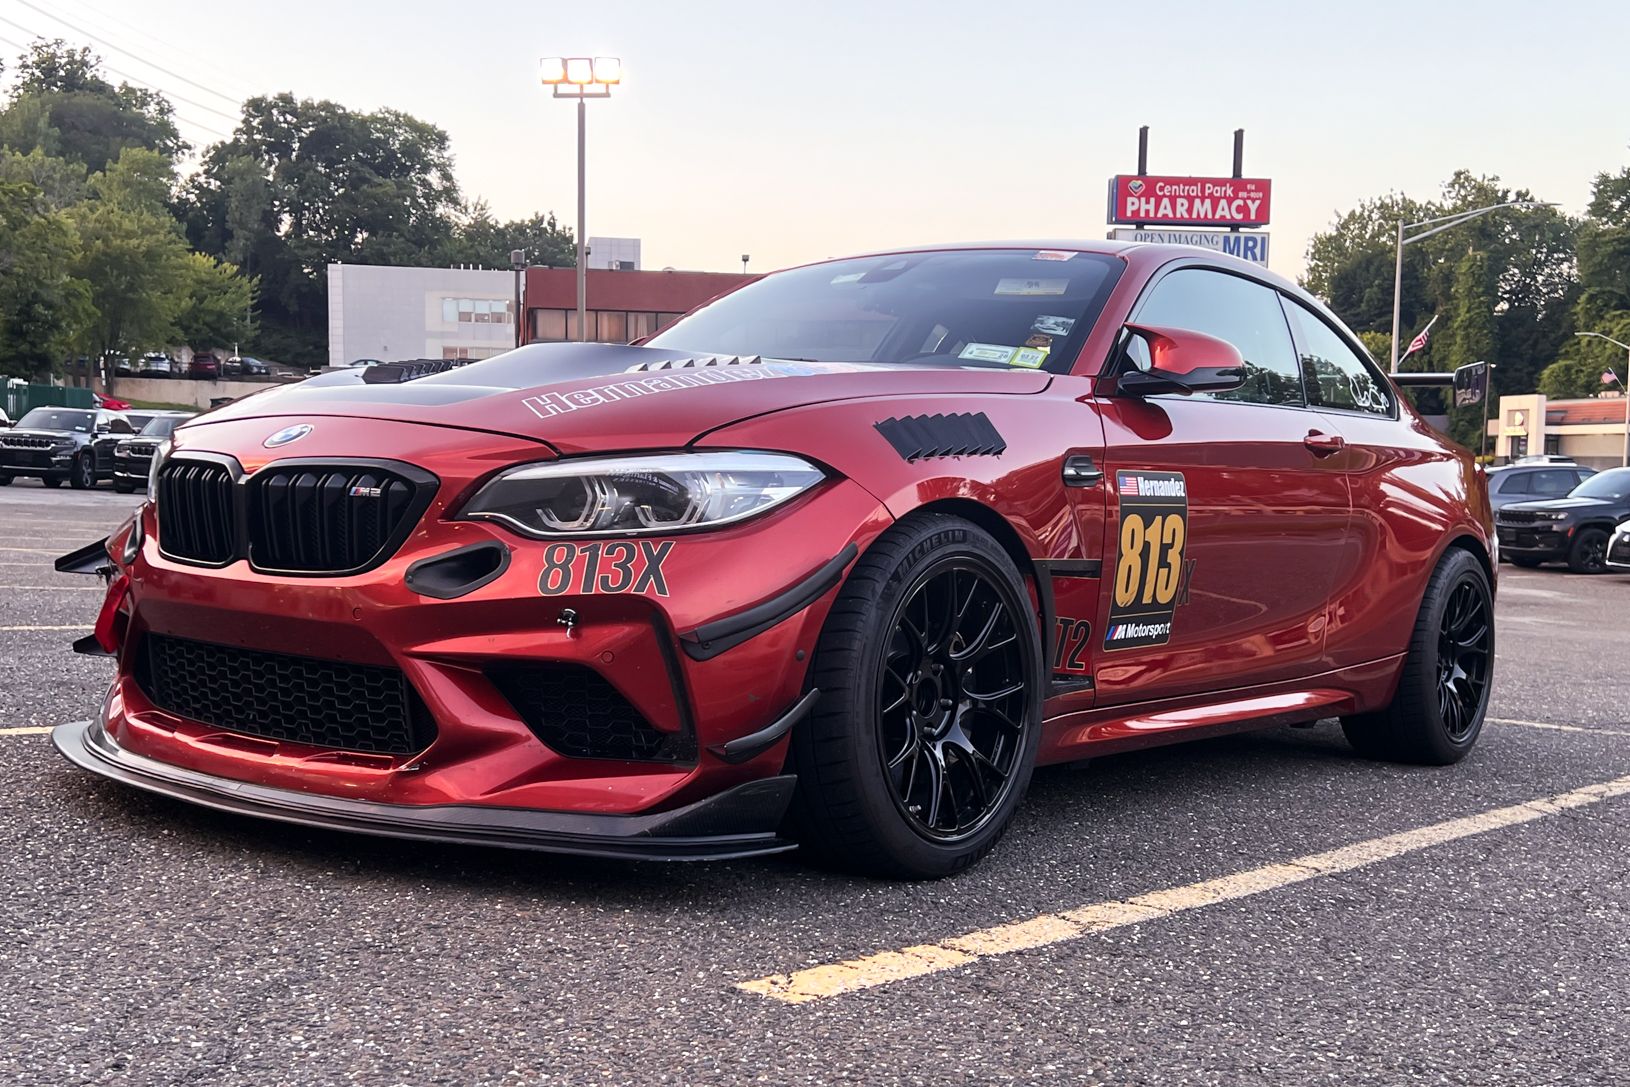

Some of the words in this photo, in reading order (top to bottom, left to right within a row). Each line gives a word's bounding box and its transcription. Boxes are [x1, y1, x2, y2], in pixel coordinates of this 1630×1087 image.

[1155, 182, 1201, 197] Central
[1205, 183, 1234, 198] Park
[1126, 197, 1261, 220] PHARMACY
[1134, 232, 1166, 244] OPEN
[1168, 233, 1219, 246] IMAGING
[1222, 235, 1266, 262] MRI
[521, 367, 788, 419] Hernandez
[352, 486, 381, 497] M2
[1137, 476, 1186, 498] Hernandez
[897, 530, 964, 577] MICHELIN
[1115, 513, 1185, 608] 813
[537, 541, 677, 598] 813X
[1125, 622, 1171, 639] Motorsport
[1053, 616, 1092, 671] T2
